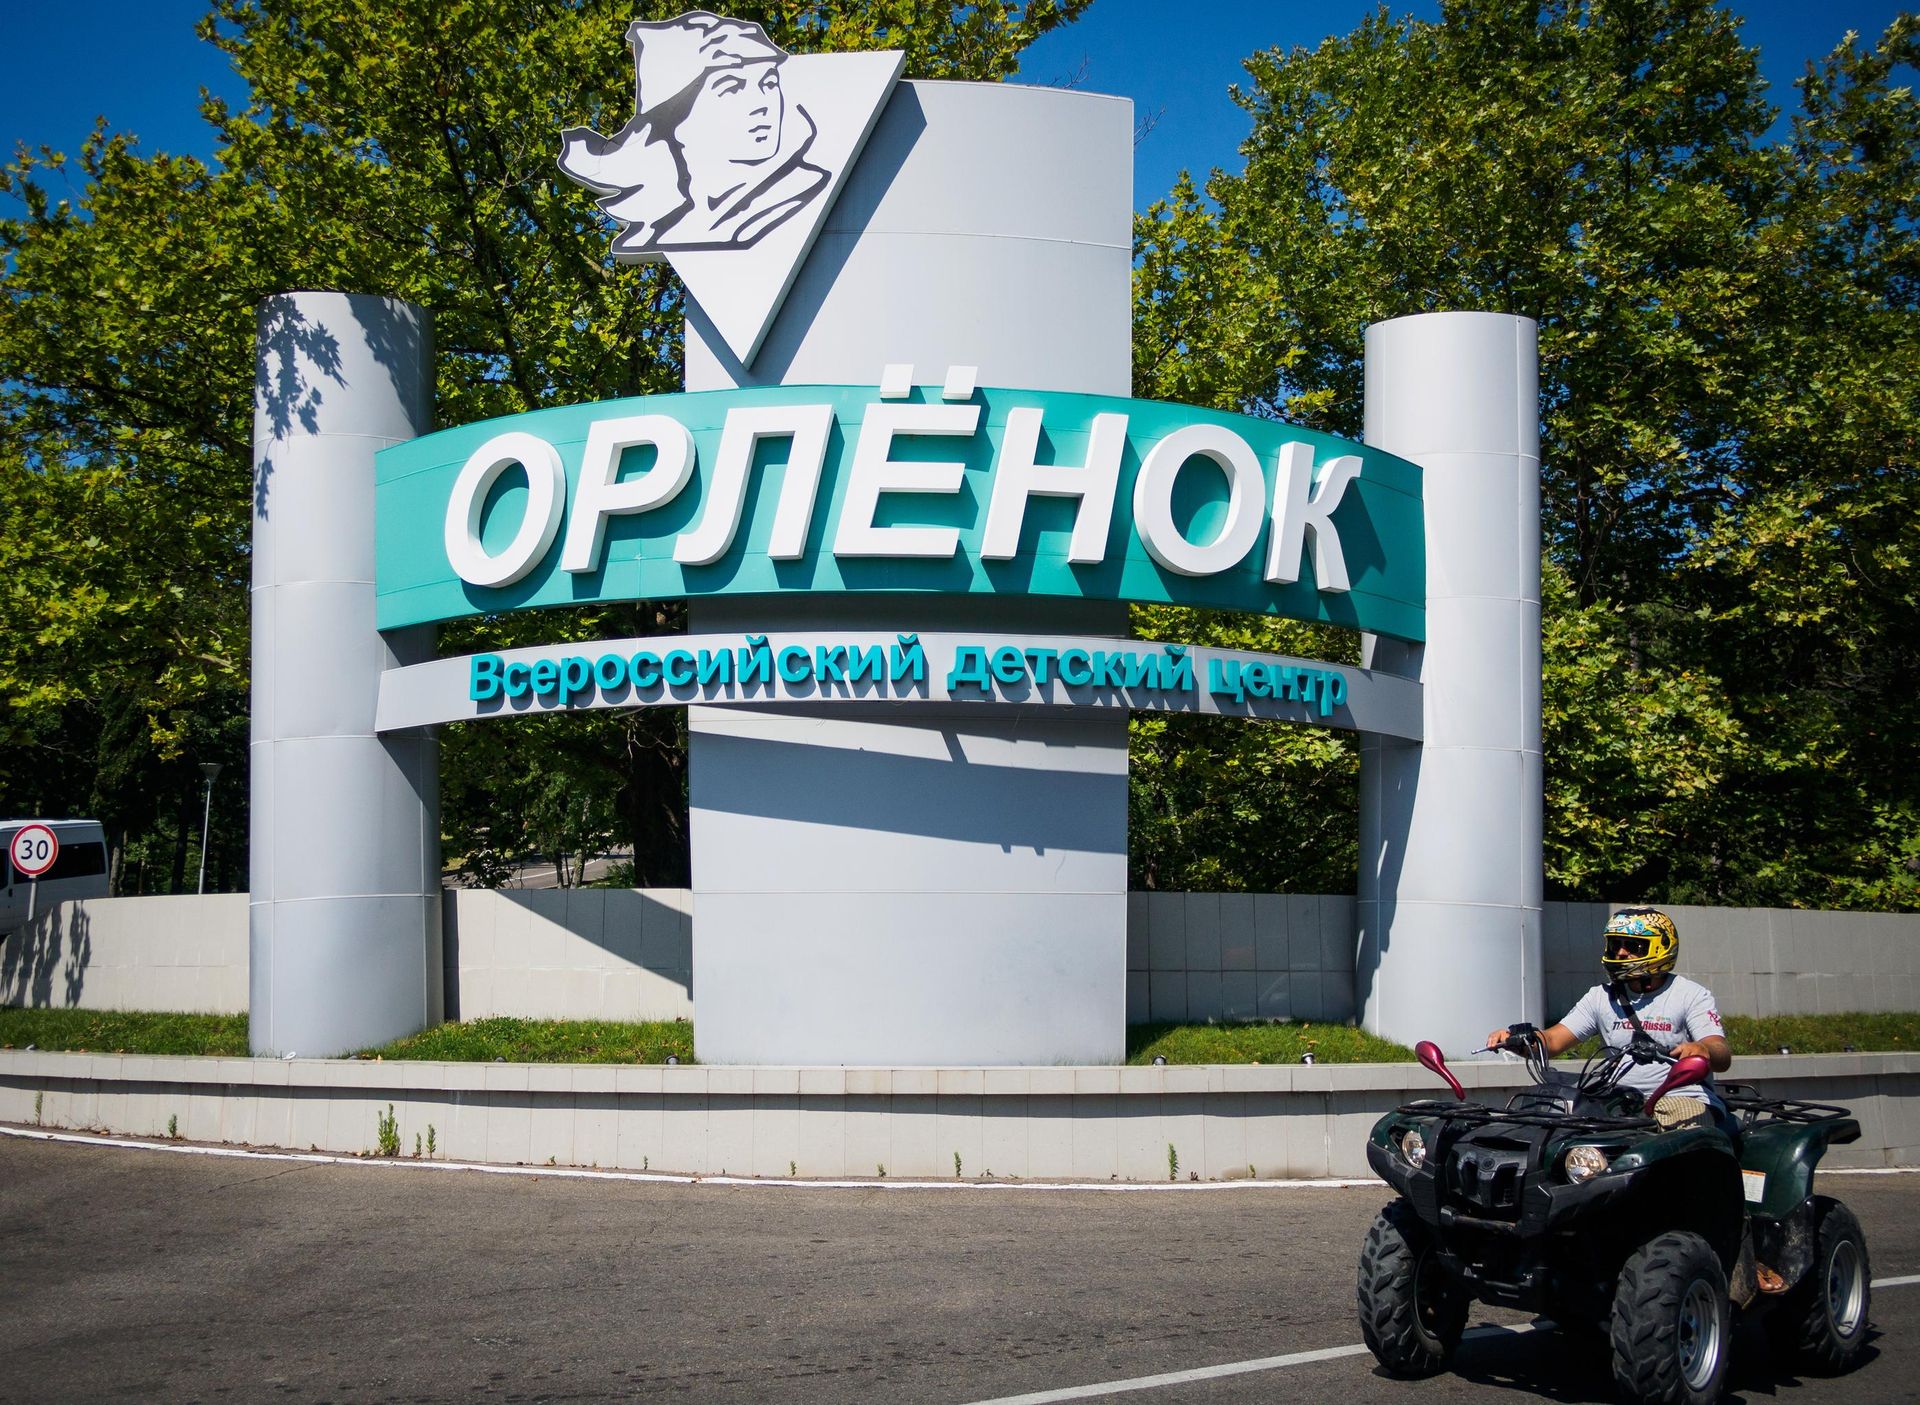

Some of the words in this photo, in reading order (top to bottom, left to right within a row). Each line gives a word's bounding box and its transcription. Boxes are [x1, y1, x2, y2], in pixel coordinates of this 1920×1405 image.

[444, 364, 1363, 592] ОРЛЁНОК
[469, 634, 924, 705] Всероссийский
[947, 644, 1192, 692] детский
[1209, 658, 1348, 716] центр
[21, 839, 49, 860] 30
